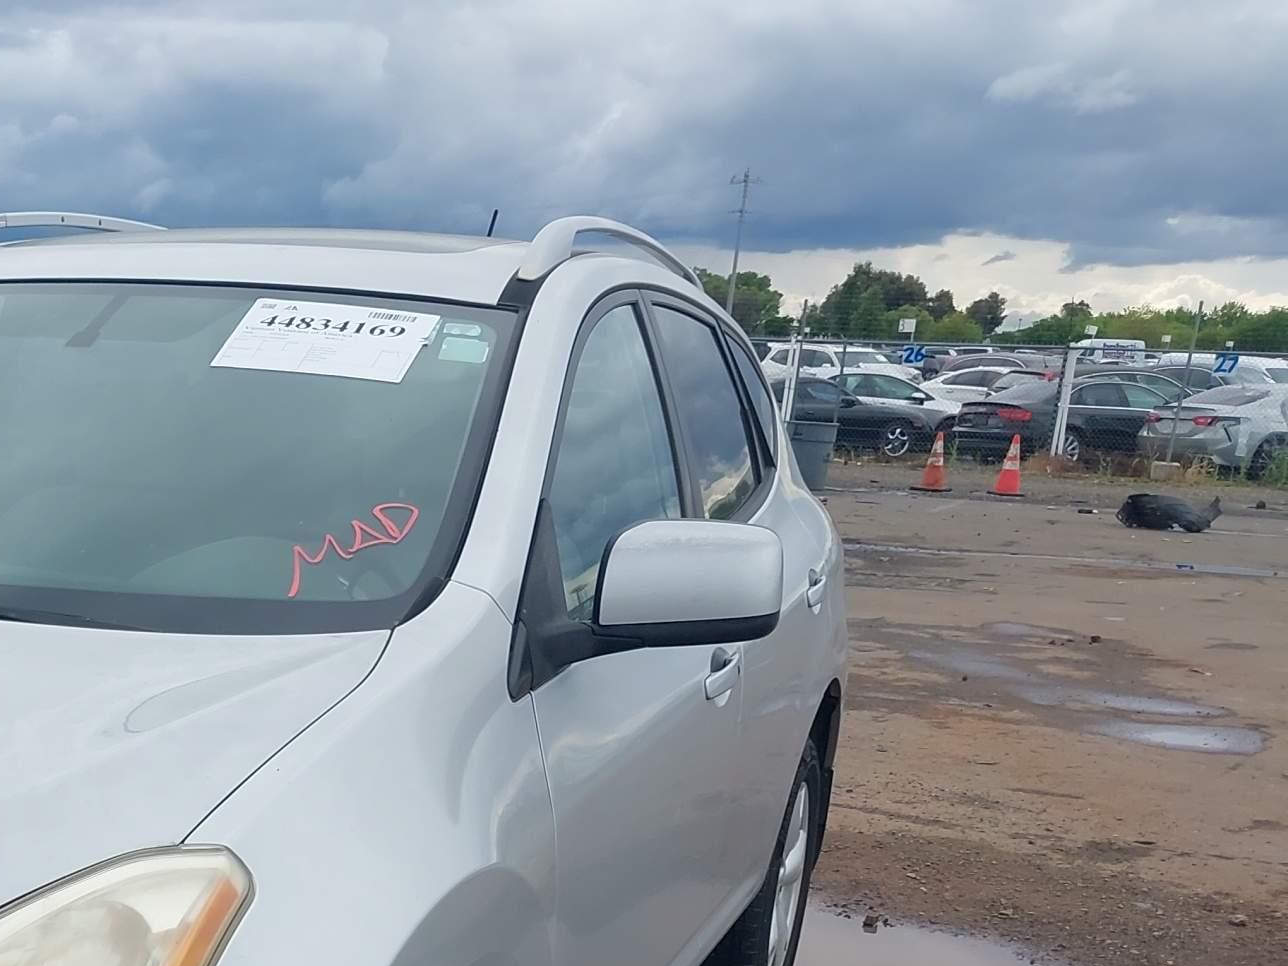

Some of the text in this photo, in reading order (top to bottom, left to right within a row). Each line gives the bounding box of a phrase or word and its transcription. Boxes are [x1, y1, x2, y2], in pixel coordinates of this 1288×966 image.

[260, 314, 407, 338] 44834169
[903, 345, 925, 363] 26
[1213, 352, 1239, 373] 27
[287, 502, 420, 598] MAD
